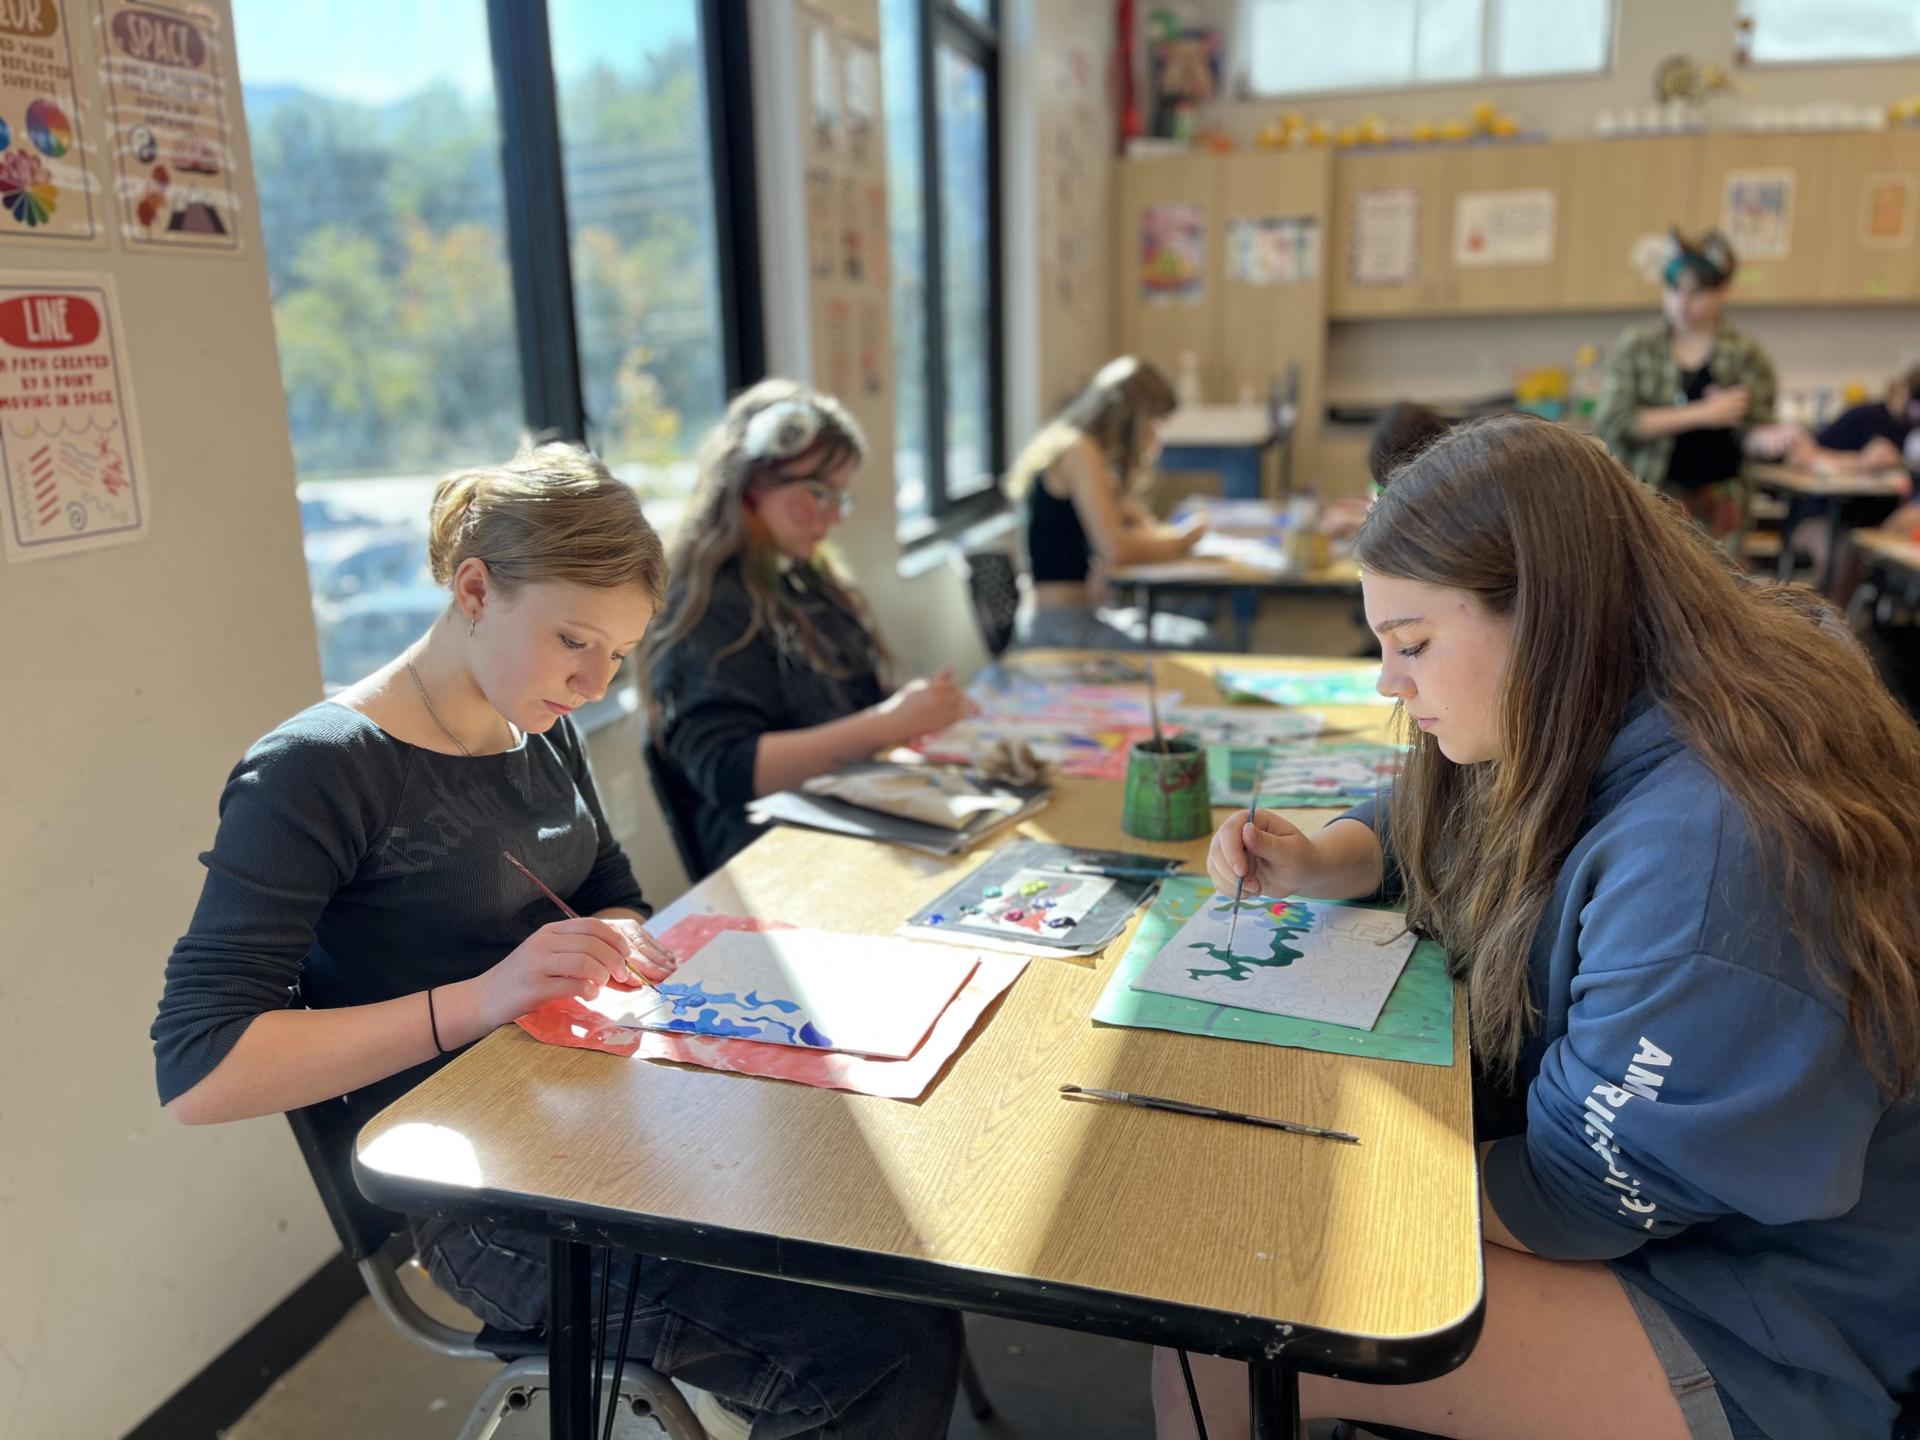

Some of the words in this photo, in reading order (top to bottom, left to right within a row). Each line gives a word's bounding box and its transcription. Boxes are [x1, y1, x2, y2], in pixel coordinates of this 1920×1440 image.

[126, 13, 192, 65] SPACE
[20, 41, 54, 59] WHEN
[1, 55, 69, 79] REFLECTED
[2, 73, 56, 94] SURFACE
[22, 299, 73, 342] LINE
[11, 357, 48, 373] PATH
[51, 354, 109, 371] CREATED
[21, 376, 37, 391] BY
[42, 375, 51, 390] A
[55, 373, 93, 388] POINT
[0, 394, 51, 410] MOVING
[55, 392, 69, 407] IN
[74, 390, 112, 405] SPACE
